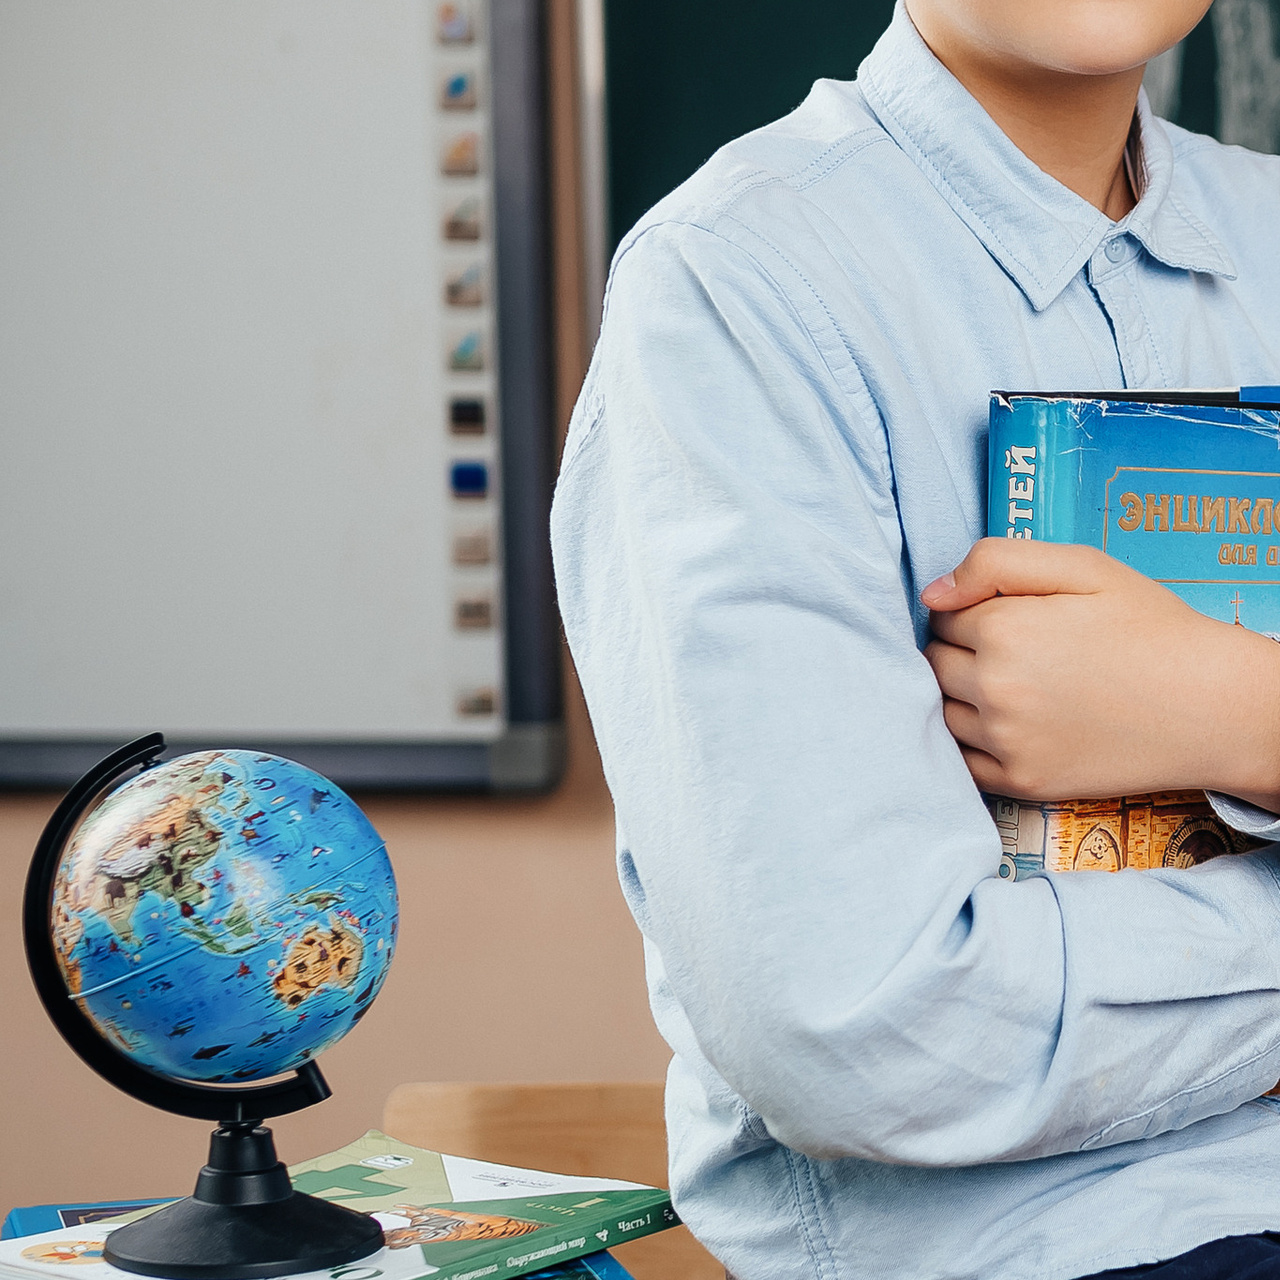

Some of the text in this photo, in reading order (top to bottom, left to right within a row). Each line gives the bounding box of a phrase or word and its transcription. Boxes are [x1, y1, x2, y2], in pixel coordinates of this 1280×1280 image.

[1004, 444, 1037, 540] ЕТЕЙ
[1218, 543, 1258, 565] ДЛЯ
[617, 1215, 645, 1233] Часть
